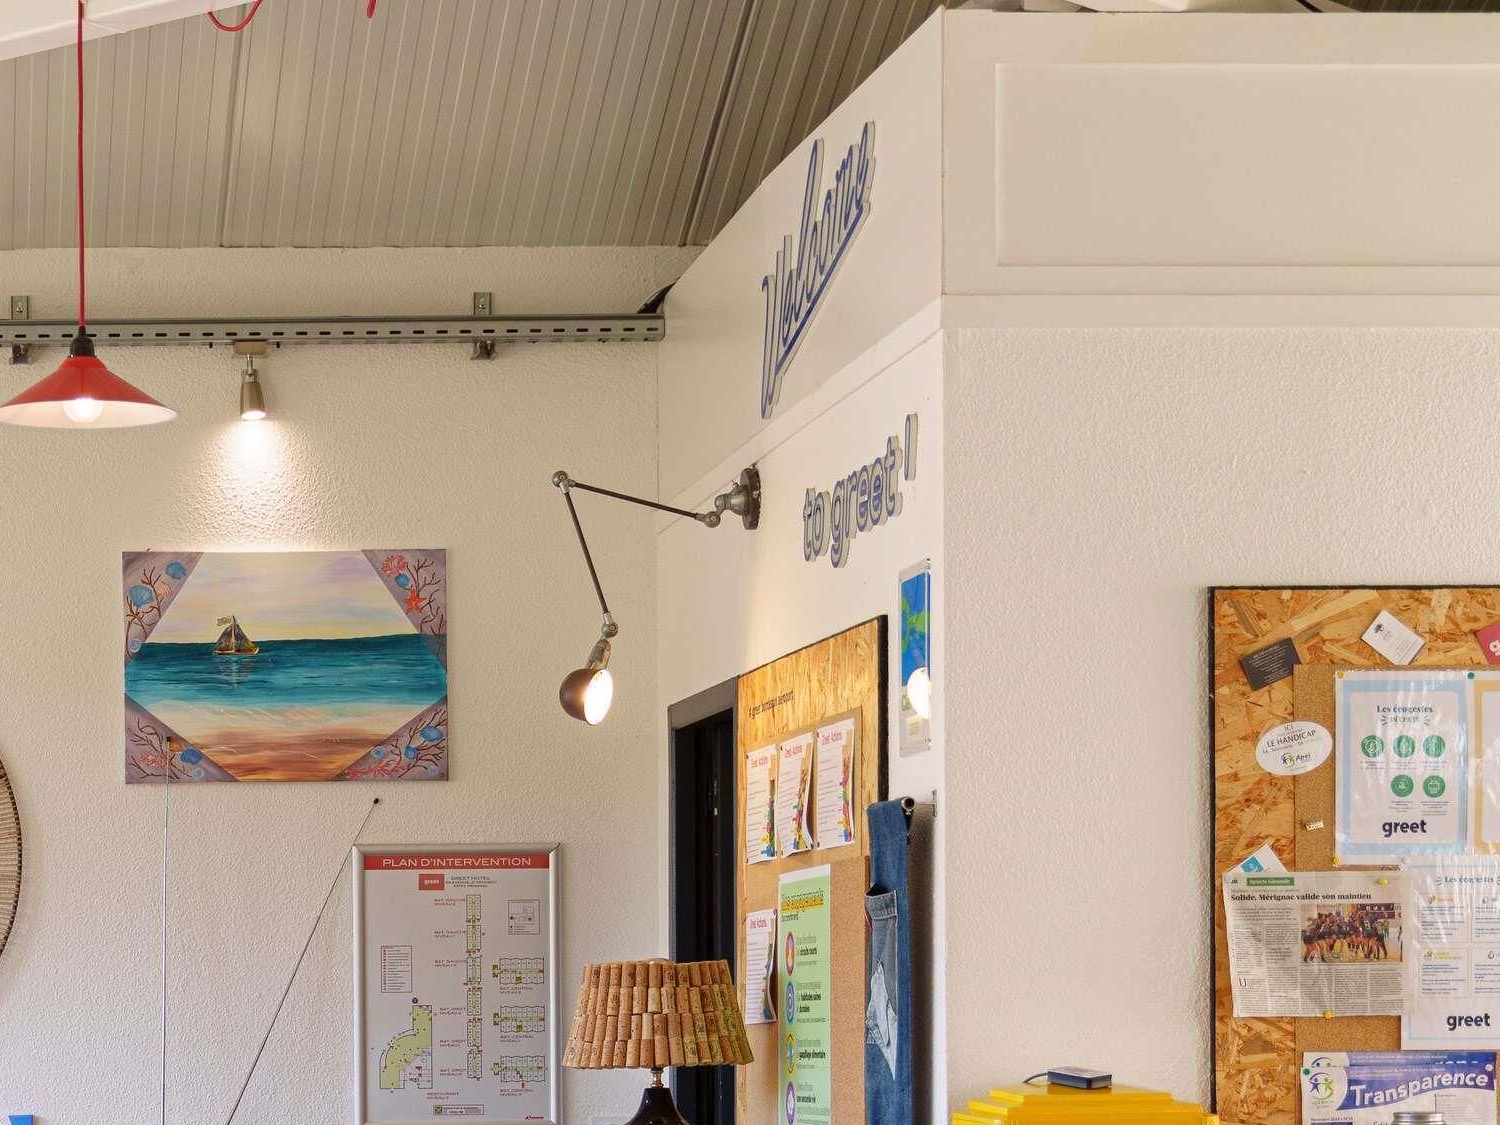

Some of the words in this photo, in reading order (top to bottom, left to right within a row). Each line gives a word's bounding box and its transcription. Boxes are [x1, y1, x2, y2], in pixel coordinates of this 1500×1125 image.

[761, 120, 875, 420] Welcome
[803, 487, 830, 562] to
[831, 435, 903, 568] greet
[1267, 740, 1275, 748] LE
[1277, 729, 1316, 745] HANDICAP
[1382, 819, 1427, 838] greet
[382, 858, 417, 867] PLAN
[420, 857, 531, 867] D'INTERVENTION
[1231, 894, 1257, 902] Solide,
[1258, 893, 1295, 902] Mérignac
[1447, 1012, 1491, 1031] greet
[1349, 1071, 1489, 1107] Transparence
